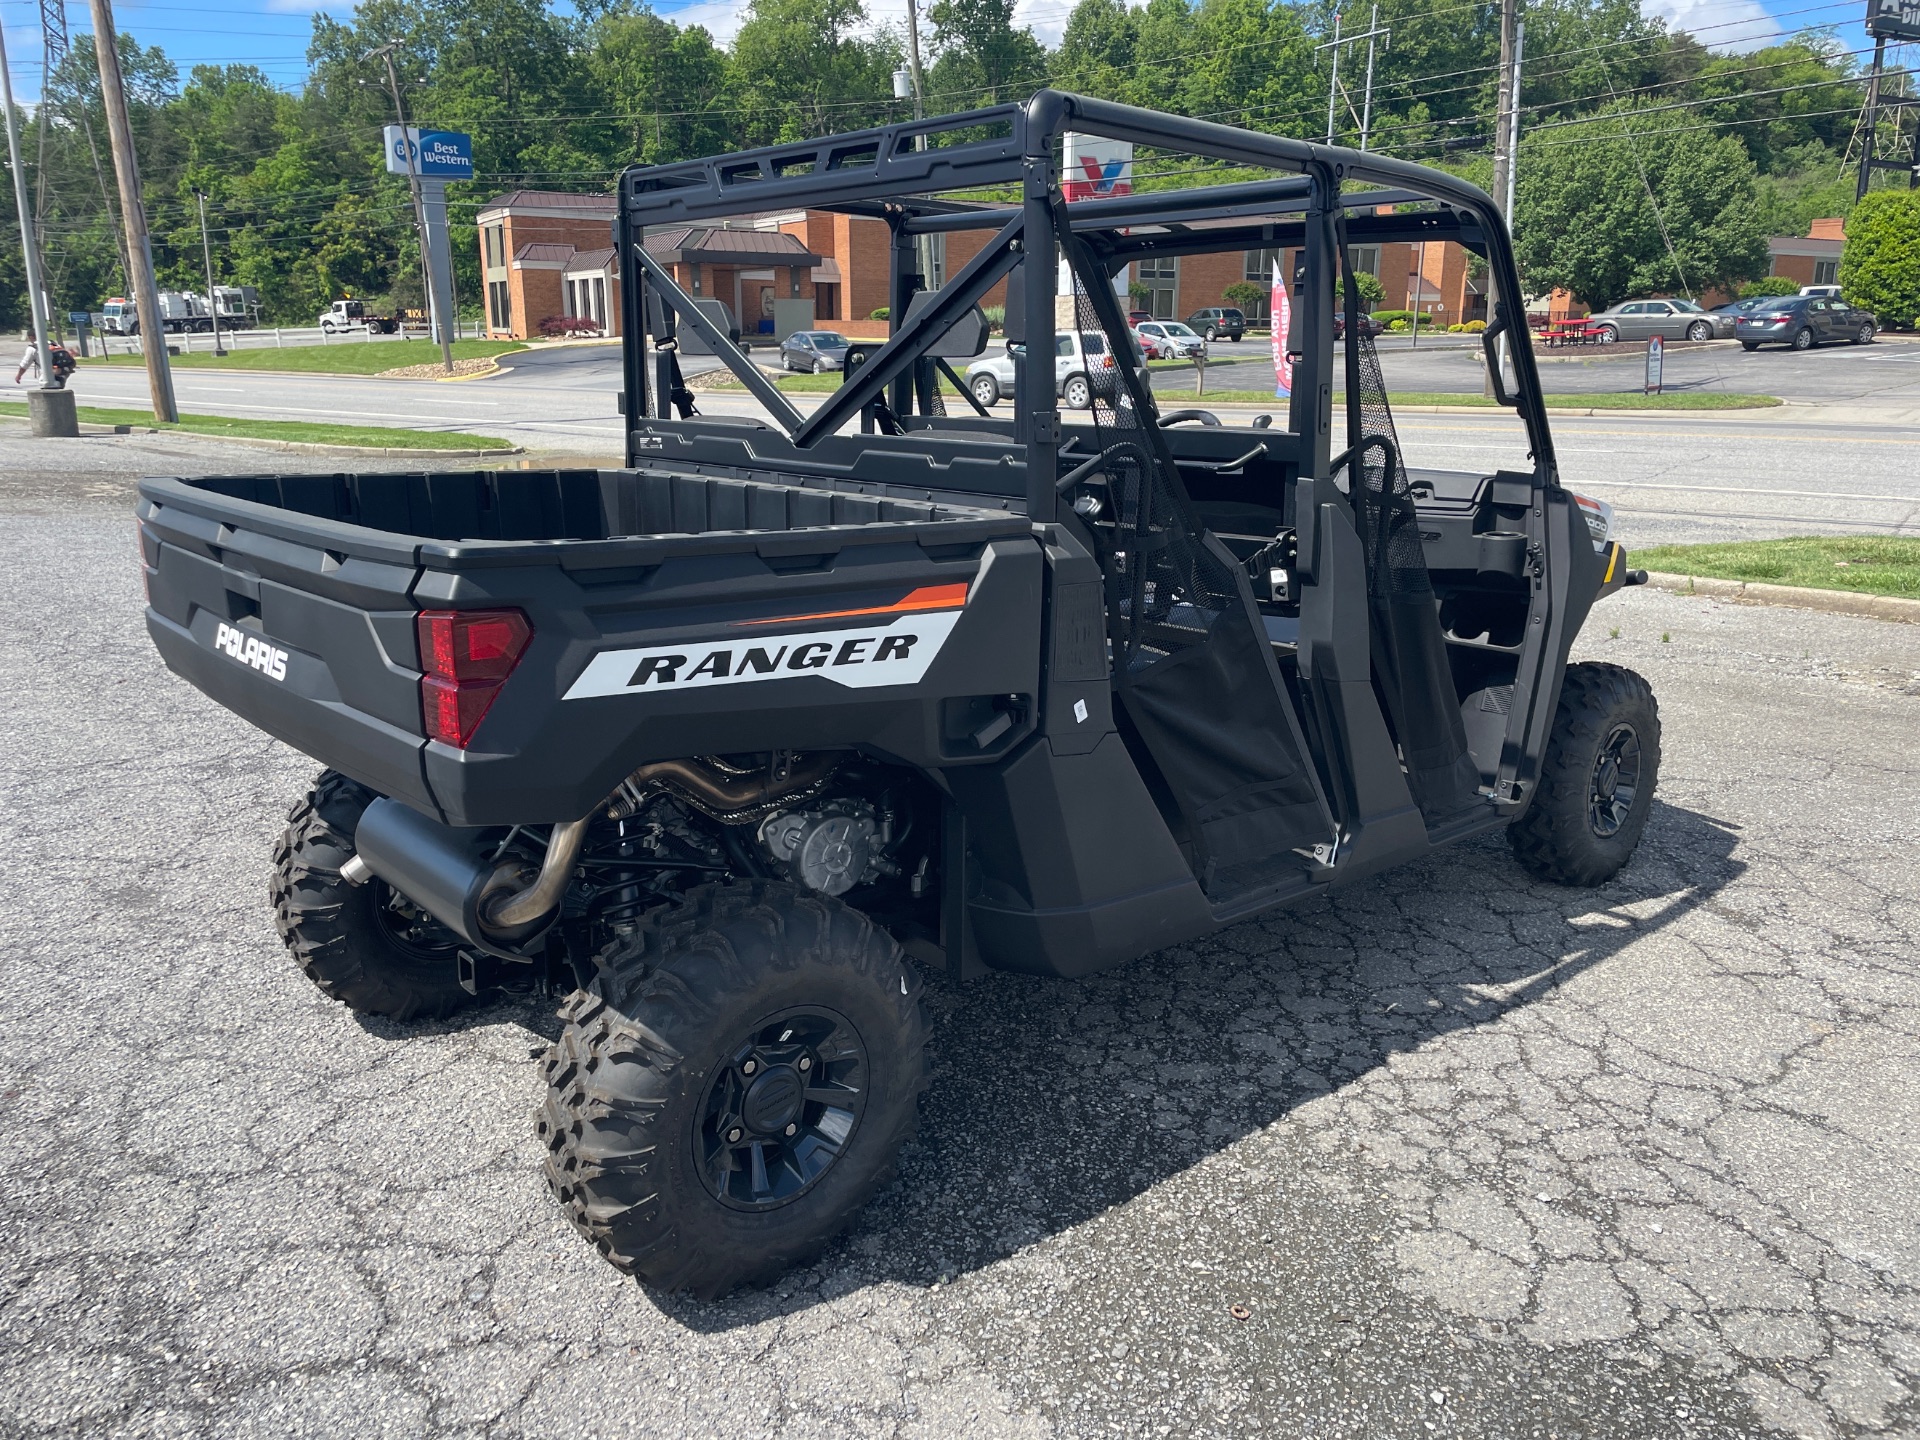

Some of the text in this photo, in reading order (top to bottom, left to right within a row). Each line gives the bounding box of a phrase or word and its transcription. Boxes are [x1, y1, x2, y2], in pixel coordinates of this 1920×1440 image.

[434, 142, 459, 154] Best
[215, 622, 289, 681] POLARIS
[626, 634, 919, 687] RANGER
